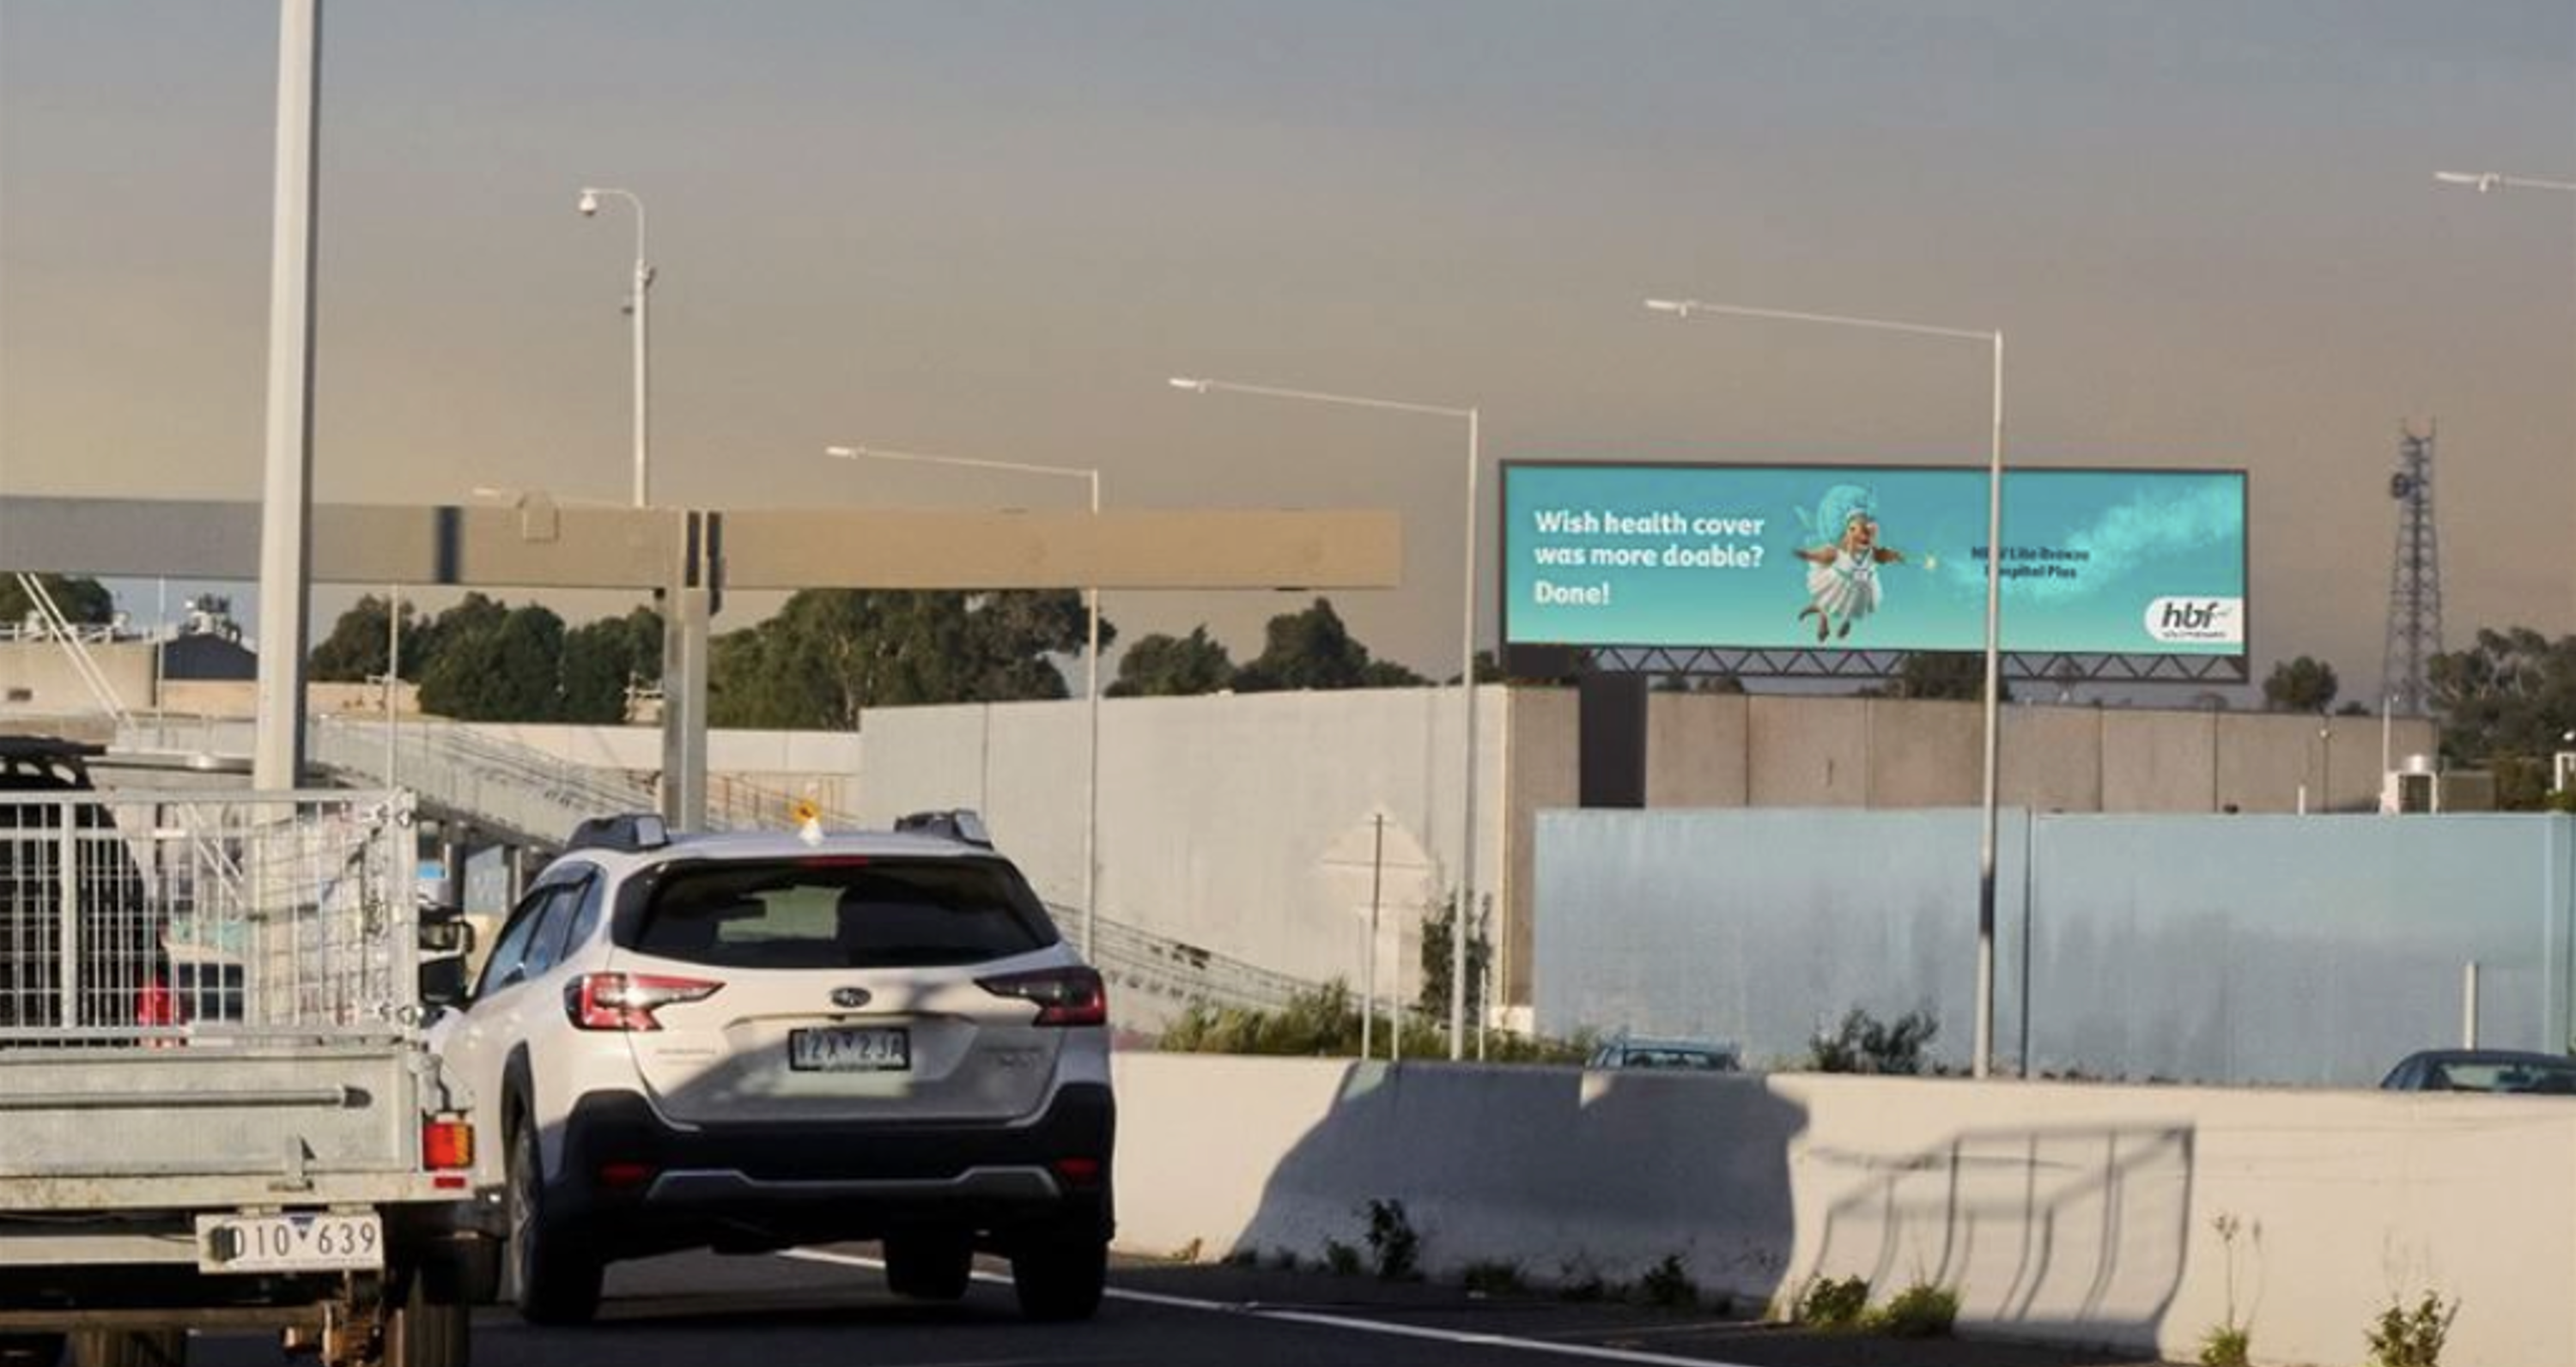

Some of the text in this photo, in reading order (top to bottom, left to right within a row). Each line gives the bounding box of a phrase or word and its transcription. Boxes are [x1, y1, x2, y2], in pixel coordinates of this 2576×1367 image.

[1534, 510, 1764, 535] Wish health cover
[1534, 544, 1764, 568] was more doable?
[1535, 580, 1609, 605] Done!
[2161, 601, 2219, 629] hbf
[318, 1220, 376, 1255] 639
